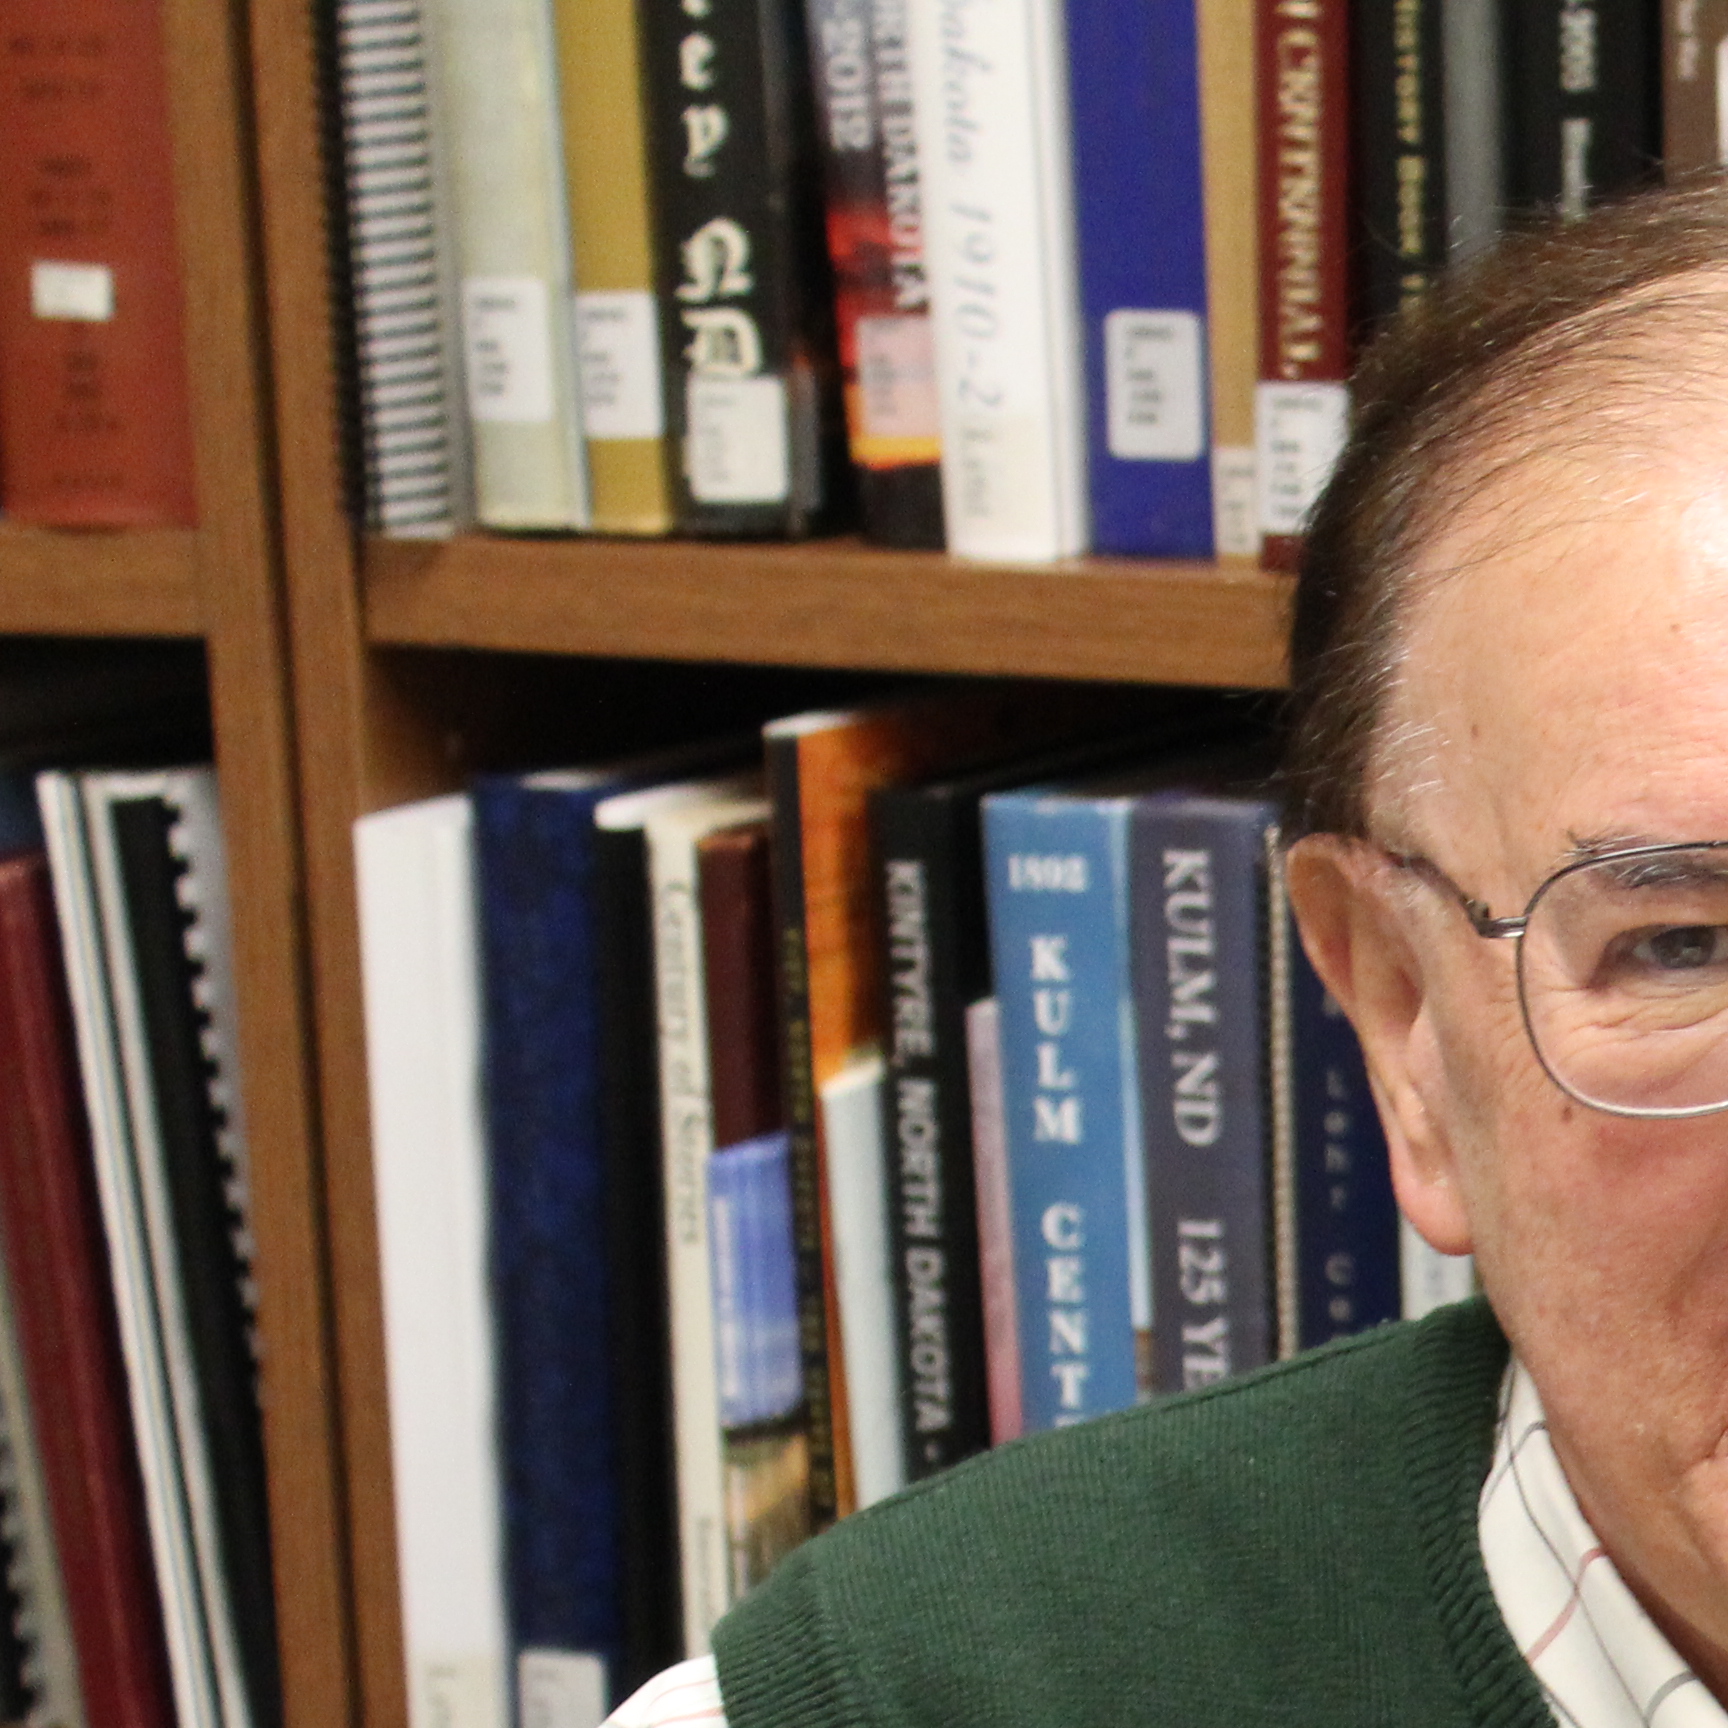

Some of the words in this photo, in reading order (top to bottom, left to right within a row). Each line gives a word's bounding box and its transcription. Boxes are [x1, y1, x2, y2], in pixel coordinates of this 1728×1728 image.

[883, 859, 931, 1067] KINTYRE,
[1030, 935, 1084, 1143] KULM
[1160, 848, 1217, 1041] KULM,
[896, 1077, 943, 1239] NORTH
[1169, 1052, 1223, 1149] ND
[903, 1249, 951, 1434] DAKOTA
[1040, 1203, 1091, 1428] CENT
[1176, 1217, 1228, 1306] 125
